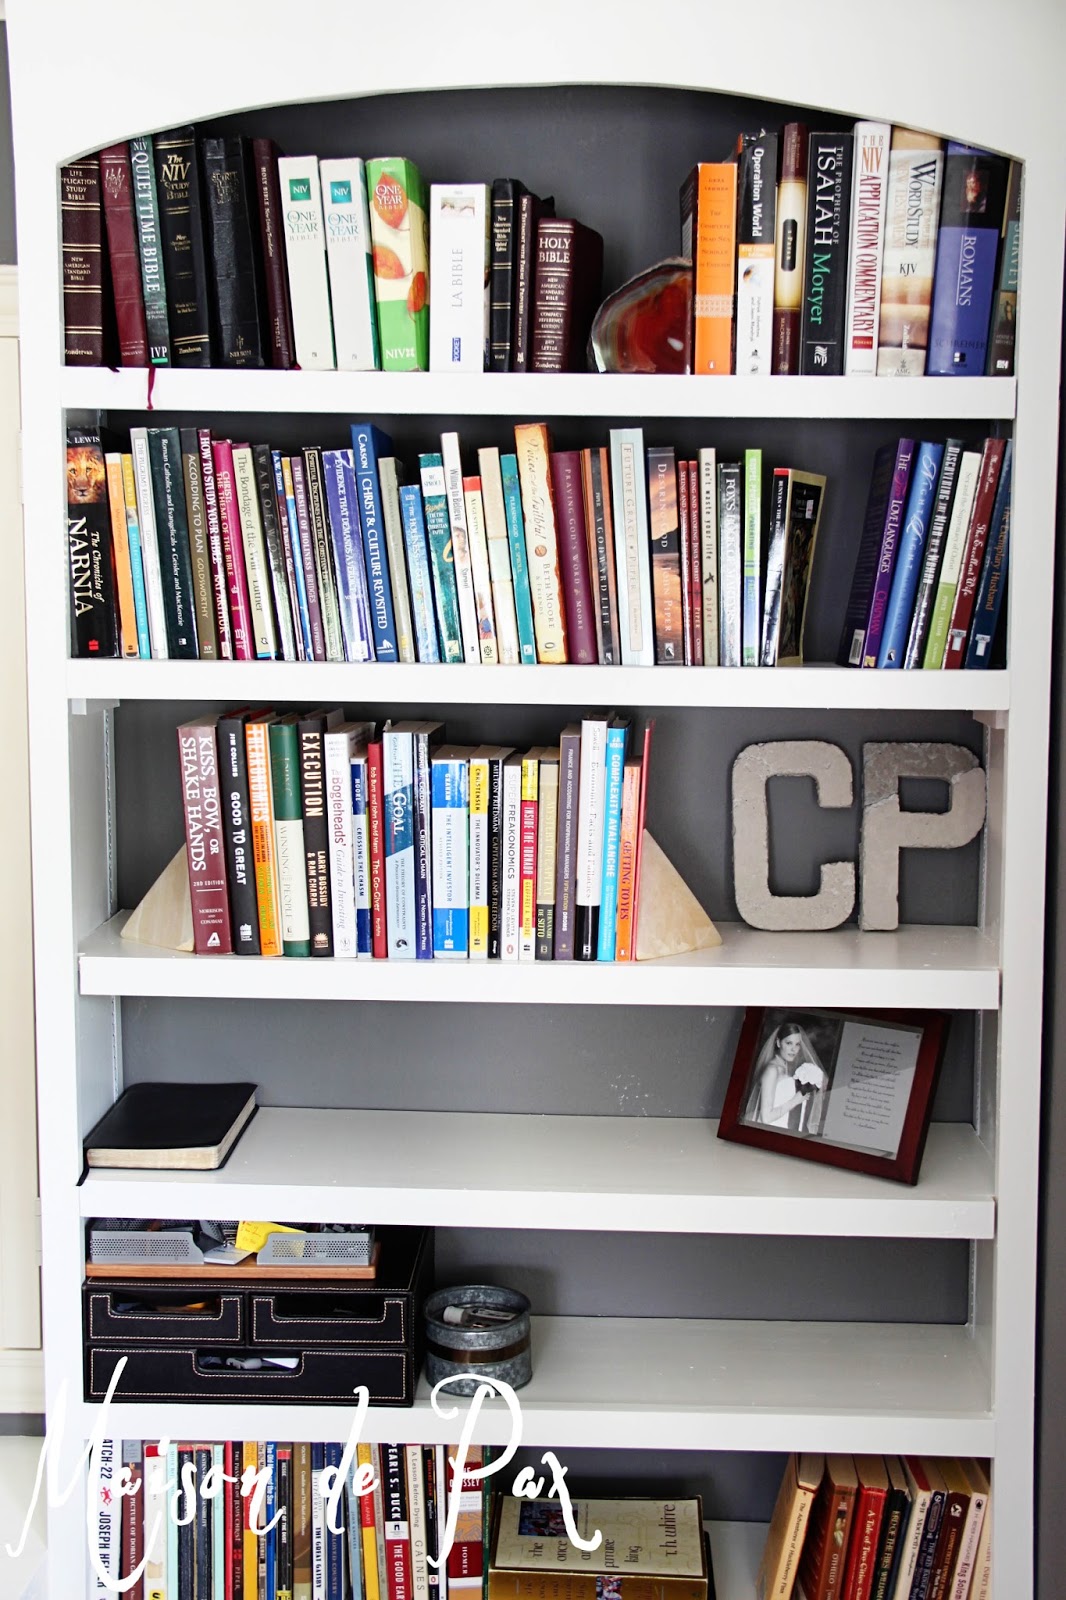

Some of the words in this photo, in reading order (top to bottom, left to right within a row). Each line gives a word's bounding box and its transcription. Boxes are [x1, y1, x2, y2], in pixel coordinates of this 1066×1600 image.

[133, 141, 148, 151] NIV
[862, 135, 884, 146] THE
[167, 154, 183, 164] The
[835, 147, 844, 166] THE
[861, 147, 883, 173] NIV
[131, 151, 151, 199] QUIET
[161, 162, 191, 182] NIV
[163, 181, 190, 191] STUDY
[751, 148, 764, 201] Operation
[65, 185, 87, 193] STUDY
[67, 193, 86, 201] BIBLE
[166, 191, 190, 200] BIBLE
[292, 185, 308, 194] NIV
[334, 188, 349, 197] NIV
[375, 184, 402, 195] ONE
[376, 195, 403, 204] YEAR
[814, 147, 837, 245] ISAIAH
[833, 171, 843, 220] PROPHECY
[138, 205, 156, 244] TIME
[287, 210, 317, 223] ONE
[327, 212, 357, 226] ONE
[751, 204, 763, 237] World
[856, 174, 881, 250] APPLICATION
[288, 223, 319, 233] YEAR
[329, 226, 359, 235] YEAR
[832, 231, 840, 244] OF
[538, 252, 570, 263] BIBLE
[539, 238, 571, 249] HOLY
[143, 248, 160, 293] BIBLE
[452, 249, 463, 286] BIBLE
[900, 263, 917, 276] KJV
[959, 236, 978, 307] ROMANS
[452, 292, 463, 308] LA
[807, 253, 831, 324] Motyer
[852, 254, 878, 336] COMMENTARY
[150, 346, 168, 358] IVP
[934, 340, 988, 349] SCHREINER
[74, 436, 100, 444] LEWIS
[358, 434, 368, 468] CARSON
[294, 466, 303, 482] THE
[624, 447, 634, 493] FUTURE
[897, 453, 911, 470] THE
[188, 454, 201, 511] ACCORDING
[258, 456, 270, 491] WAR
[264, 500, 273, 520] OF
[334, 460, 346, 495] EVIDENCE
[564, 469, 574, 514] PRAYING
[657, 463, 668, 515] DESIRING
[296, 484, 307, 517] PURSUIT
[340, 497, 348, 516] THAT
[361, 478, 375, 516] CHRIST
[726, 478, 736, 511] FOX'S
[192, 513, 201, 526] TO
[300, 520, 308, 530] OF
[366, 517, 376, 527] &
[626, 499, 635, 539] GRACE
[889, 500, 903, 522] LOVE
[90, 531, 100, 547] The
[194, 529, 203, 553] PLAN
[342, 518, 353, 554] DEMANDS
[568, 518, 577, 550] GOD'S
[659, 521, 669, 548] GOD
[975, 523, 987, 539] The
[301, 532, 313, 570] HOLINESS
[368, 529, 382, 576] CULTURE
[880, 522, 901, 573] LANGUAGES
[966, 540, 984, 576] Excellent
[992, 524, 1009, 569] Exemplary
[69, 517, 94, 617] NARNIA
[93, 550, 105, 590] Chronicles
[542, 563, 553, 590] BETH
[571, 554, 581, 584] WORD
[628, 556, 637, 590] PIPER
[662, 567, 671, 595] JOHN
[94, 592, 105, 602] of
[197, 558, 209, 618] GOLDSWORTHY
[307, 574, 317, 603] BRIDGES
[962, 576, 976, 597] Wife
[985, 572, 1001, 611] Husband
[373, 579, 388, 629] REVISITED
[545, 593, 555, 629] MOORE
[575, 600, 584, 630] MOORE
[664, 600, 673, 632] PIPER
[870, 591, 886, 635] CHAPMAN
[229, 733, 238, 746] JIM
[592, 728, 600, 751] Sowell
[181, 737, 200, 799] SHAKE
[197, 736, 217, 782] KISS,
[230, 747, 239, 777] COLLINS
[247, 724, 270, 821] FREAKONOMICS
[302, 733, 323, 817] EXECUTION
[392, 761, 404, 788] THE
[491, 764, 499, 793] MILTON
[590, 762, 598, 808] Economic
[610, 755, 620, 814] COMPLEXITY
[202, 786, 220, 833] BOW,
[231, 792, 242, 825] GOOD
[329, 777, 346, 847] Bogleheads'
[392, 793, 407, 835] GOAL
[491, 795, 499, 833] FRIEDMAN
[523, 807, 534, 830] INSIDE
[188, 805, 207, 871] HANDS
[233, 829, 247, 844] TO
[523, 832, 534, 845] THE
[588, 812, 597, 836] Facts
[209, 838, 220, 855] OR
[280, 826, 290, 874] WINNING
[419, 829, 427, 857] CRITICAL
[587, 840, 595, 856] and
[606, 817, 617, 877] AVALANCHE
[234, 847, 247, 885] GREAT
[317, 851, 327, 874] LARRY
[336, 850, 346, 877] Guide
[372, 860, 380, 875] The
[419, 858, 427, 879] CHAIN
[522, 846, 534, 875] TORNADO
[622, 840, 632, 884] GETTING
[319, 876, 329, 907] BOSSIDY
[373, 877, 381, 911] Go-Giver
[586, 860, 595, 898] Fallacies
[621, 887, 630, 901] TO
[283, 883, 293, 918] PEOPLE
[336, 889, 347, 929] Investing
[620, 901, 629, 920] YES
[101, 1439, 112, 1479] ATCH-22
[388, 1443, 398, 1473] PEARL
[390, 1478, 399, 1488] S.
[391, 1493, 400, 1519] BUCK
[99, 1512, 111, 1549] JOSEPH
[393, 1544, 403, 1558] THE
[415, 1540, 425, 1590] GAINES
[557, 1540, 568, 1562] once
[624, 1545, 642, 1563] king
[395, 1561, 404, 1583] GOOD
[828, 1554, 839, 1584] OTHELLO
[957, 1562, 970, 1578] King
